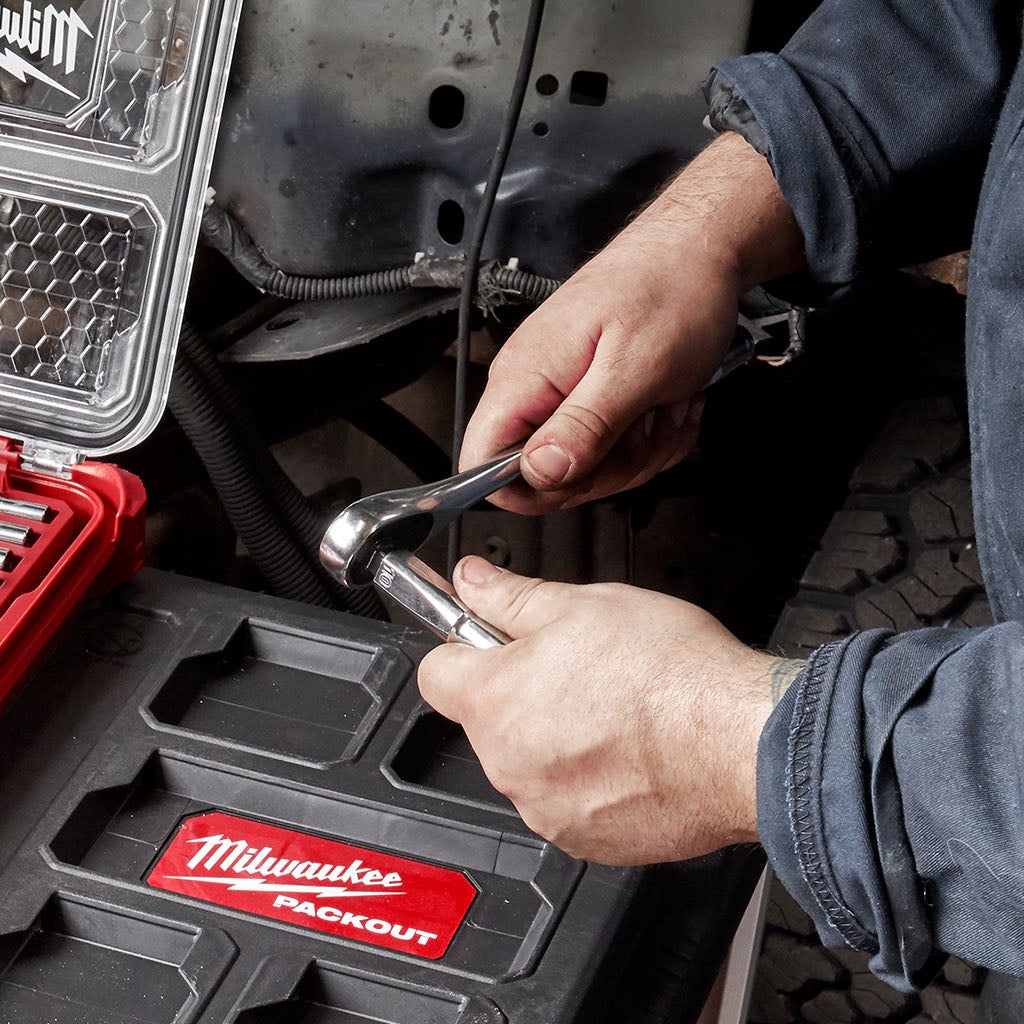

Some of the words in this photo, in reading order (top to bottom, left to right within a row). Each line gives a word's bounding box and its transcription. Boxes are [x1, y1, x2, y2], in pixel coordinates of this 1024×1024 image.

[378, 564, 394, 589] 10
[185, 833, 404, 888] Milwaukee
[272, 894, 438, 946] PACKOUT
